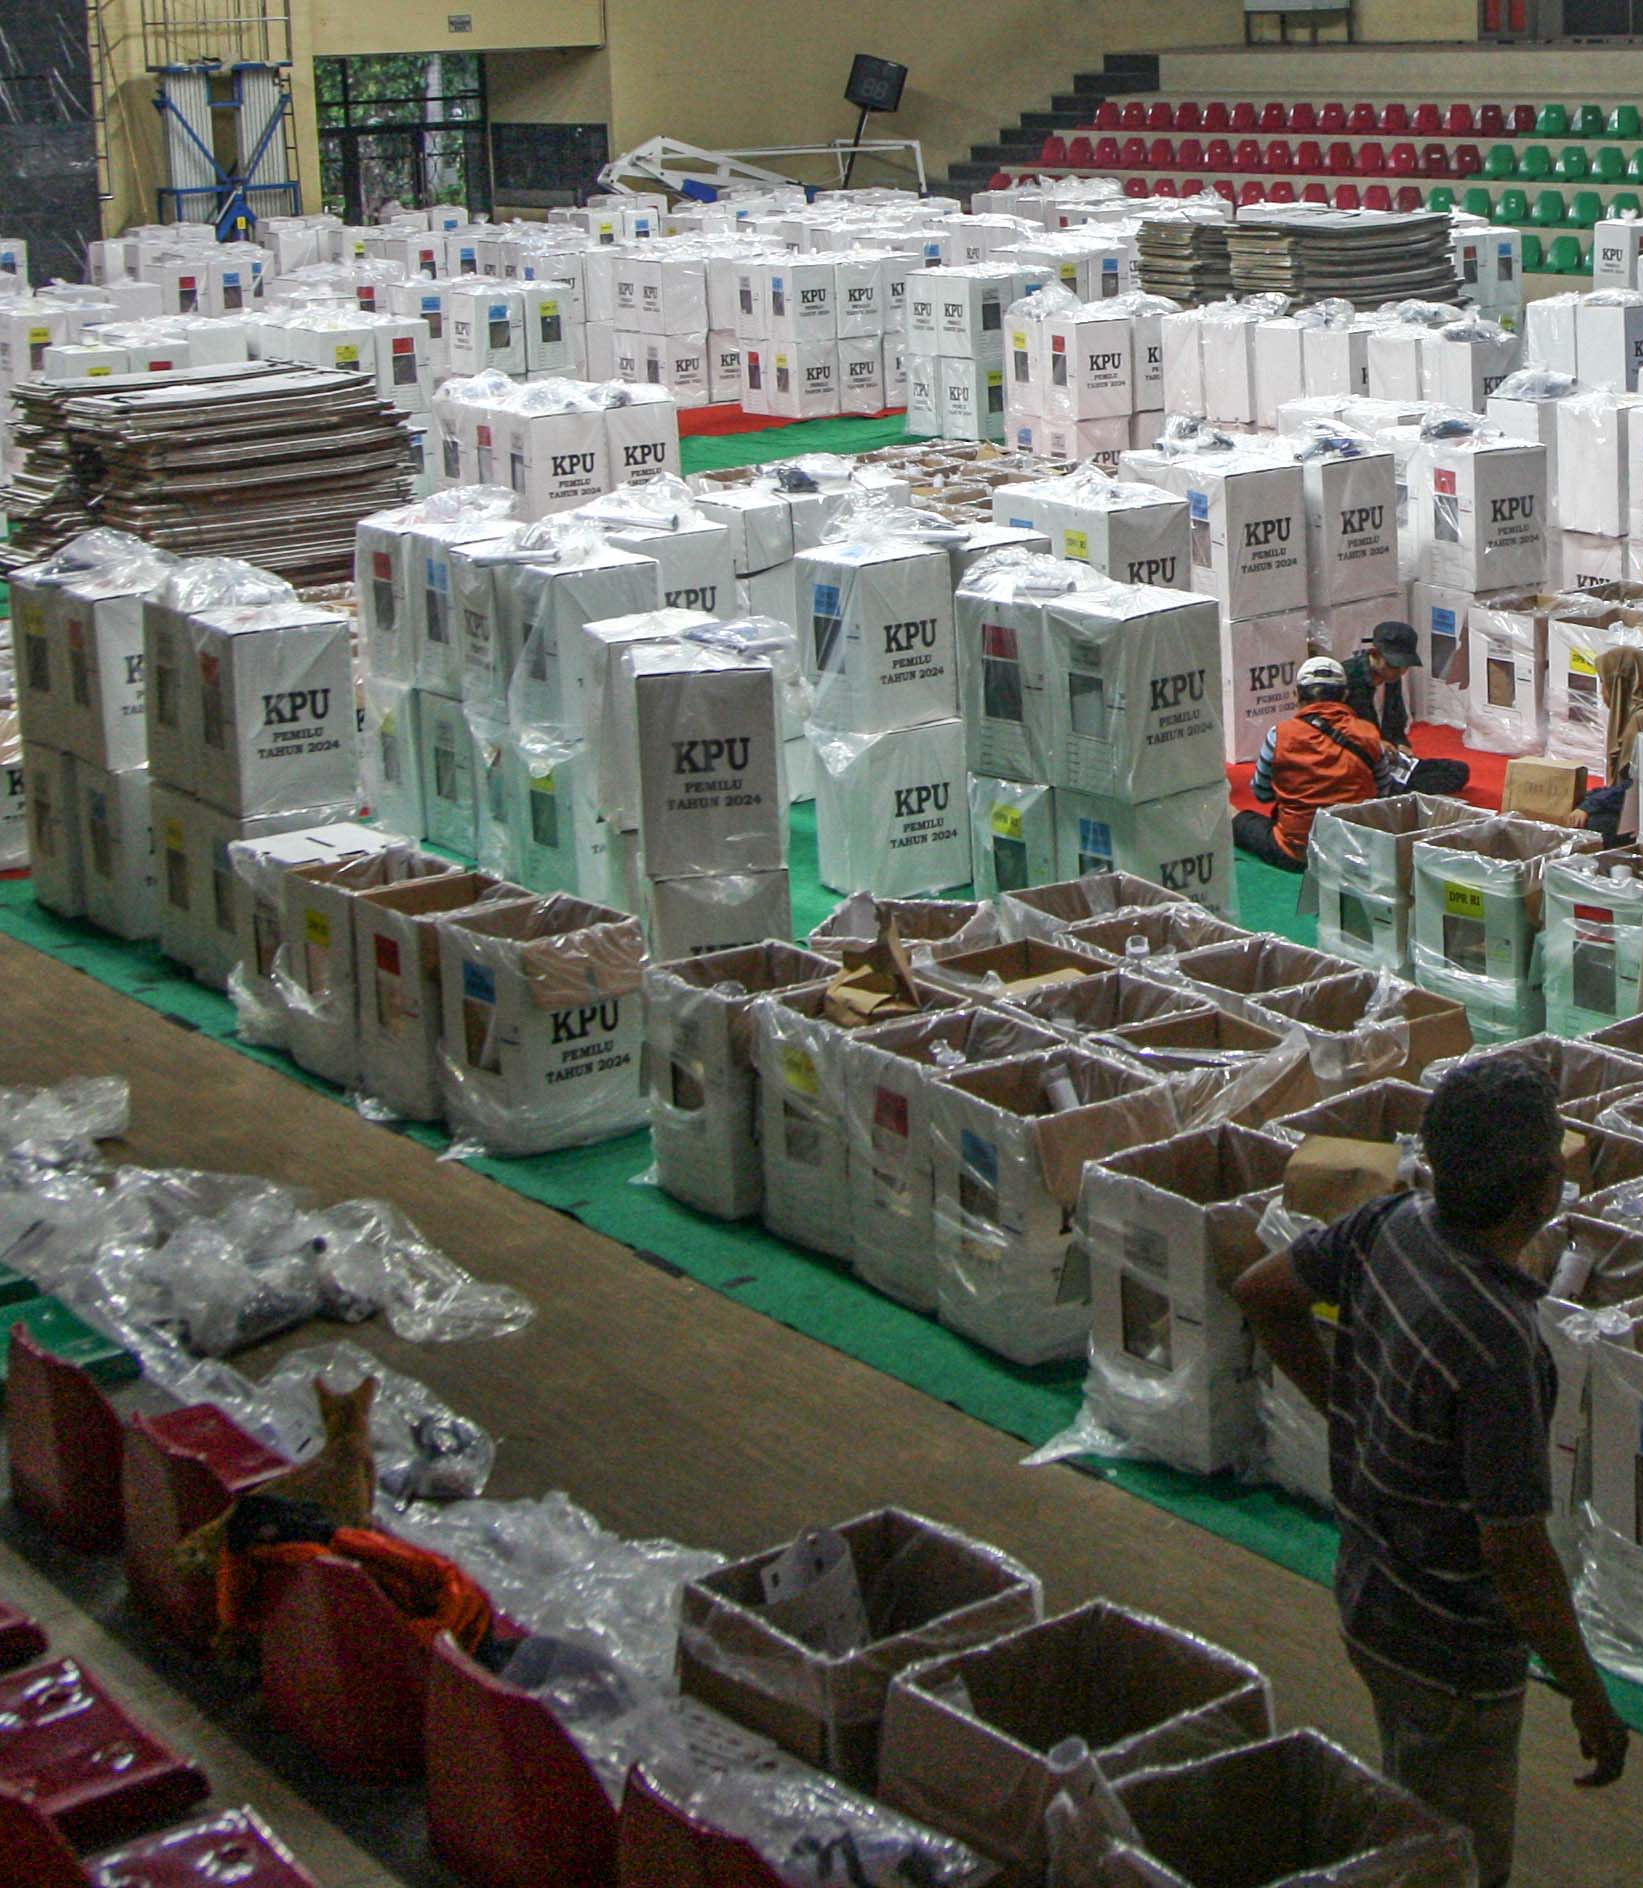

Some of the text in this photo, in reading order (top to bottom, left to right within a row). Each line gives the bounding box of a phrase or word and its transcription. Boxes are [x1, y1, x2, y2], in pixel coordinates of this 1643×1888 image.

[1602, 248, 1623, 262] KPU
[801, 289, 826, 303] KPU
[848, 288, 873, 302] KPU
[944, 304, 963, 318] KPU
[675, 358, 699, 372] KPU
[850, 362, 874, 376] KPU
[1089, 353, 1121, 370] KPU
[806, 366, 831, 381] KPU
[624, 443, 666, 467] KPU
[552, 453, 595, 477] KPU
[548, 487, 602, 499] TAHUN 2024
[558, 478, 591, 489] PEMILU
[1490, 495, 1534, 523] KPU
[1340, 505, 1383, 535] KPU
[1497, 523, 1530, 536] PEMILU
[1245, 517, 1291, 547] KPU
[1347, 535, 1380, 548] PEMILU
[1487, 534, 1540, 549] TAHUN 2024
[1252, 548, 1287, 560] PEMILU
[1337, 546, 1390, 561] TAHUN 2024
[1128, 557, 1176, 585] KPU
[1241, 558, 1298, 574] TAHUN 2024
[664, 586, 717, 612] KPU
[884, 618, 936, 653] KPU
[892, 654, 933, 669] PEMILU
[880, 666, 945, 685] TAHUN 2024
[1249, 661, 1295, 691] KPU
[1150, 669, 1206, 712] KPU
[262, 688, 330, 726] KPU
[1159, 709, 1201, 728] PEMILU
[272, 727, 325, 743] PEMILU
[1146, 722, 1215, 746] TAHUN 2024
[257, 740, 340, 760] TAHUN 2024
[673, 737, 751, 775] KPU
[684, 778, 743, 792] PEMILU
[667, 794, 762, 811] TAHUN 2024
[894, 782, 951, 818] KPU
[903, 818, 945, 833] PEMILU
[890, 829, 959, 849] TAHUN 2024
[1160, 853, 1215, 890] KPU
[551, 1000, 620, 1046] KPU
[562, 1040, 614, 1063] PEMILU
[545, 1053, 631, 1086] TAHUN 2024
